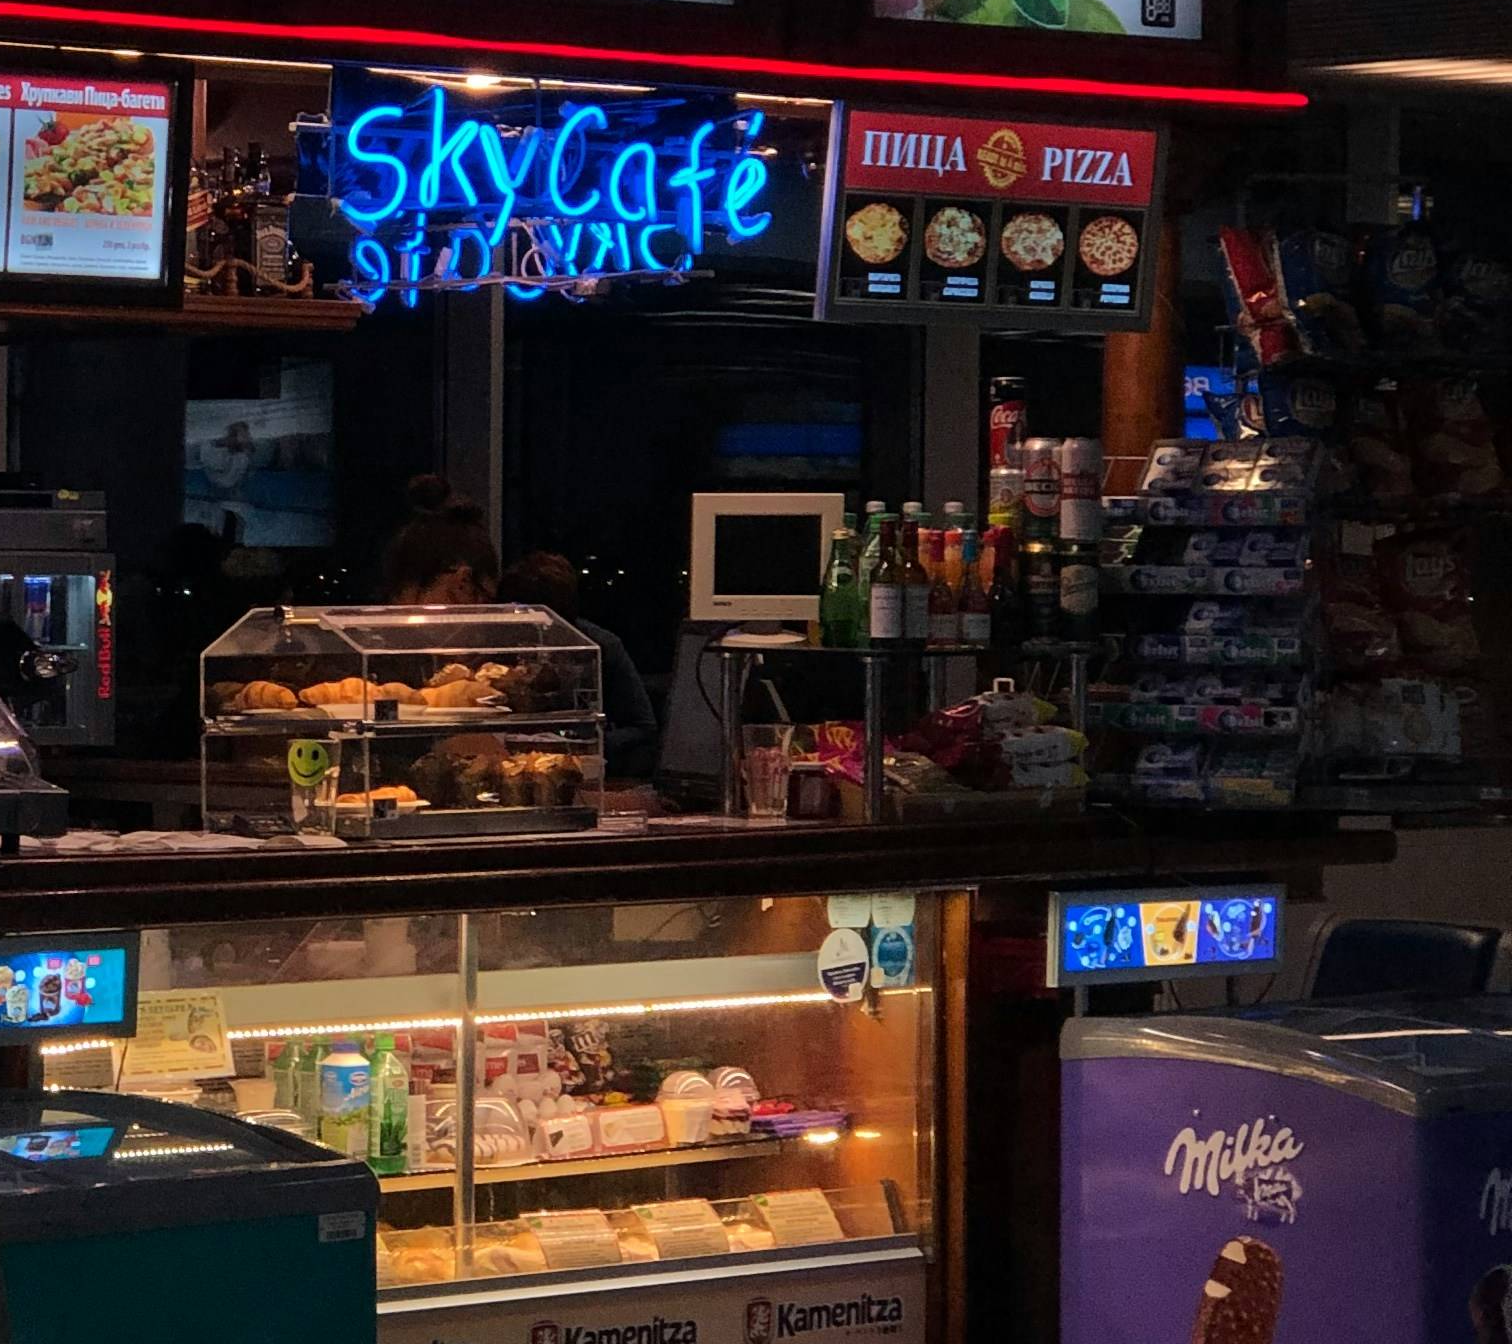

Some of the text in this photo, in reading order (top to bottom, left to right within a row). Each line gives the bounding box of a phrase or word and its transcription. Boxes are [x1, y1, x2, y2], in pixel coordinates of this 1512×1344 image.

[861, 130, 967, 177] ПИЦА
[1040, 146, 1133, 187] PIZZA
[549, 106, 777, 256] Café
[1164, 1118, 1304, 1196] Milka
[776, 1292, 904, 1338] Kamenitza
